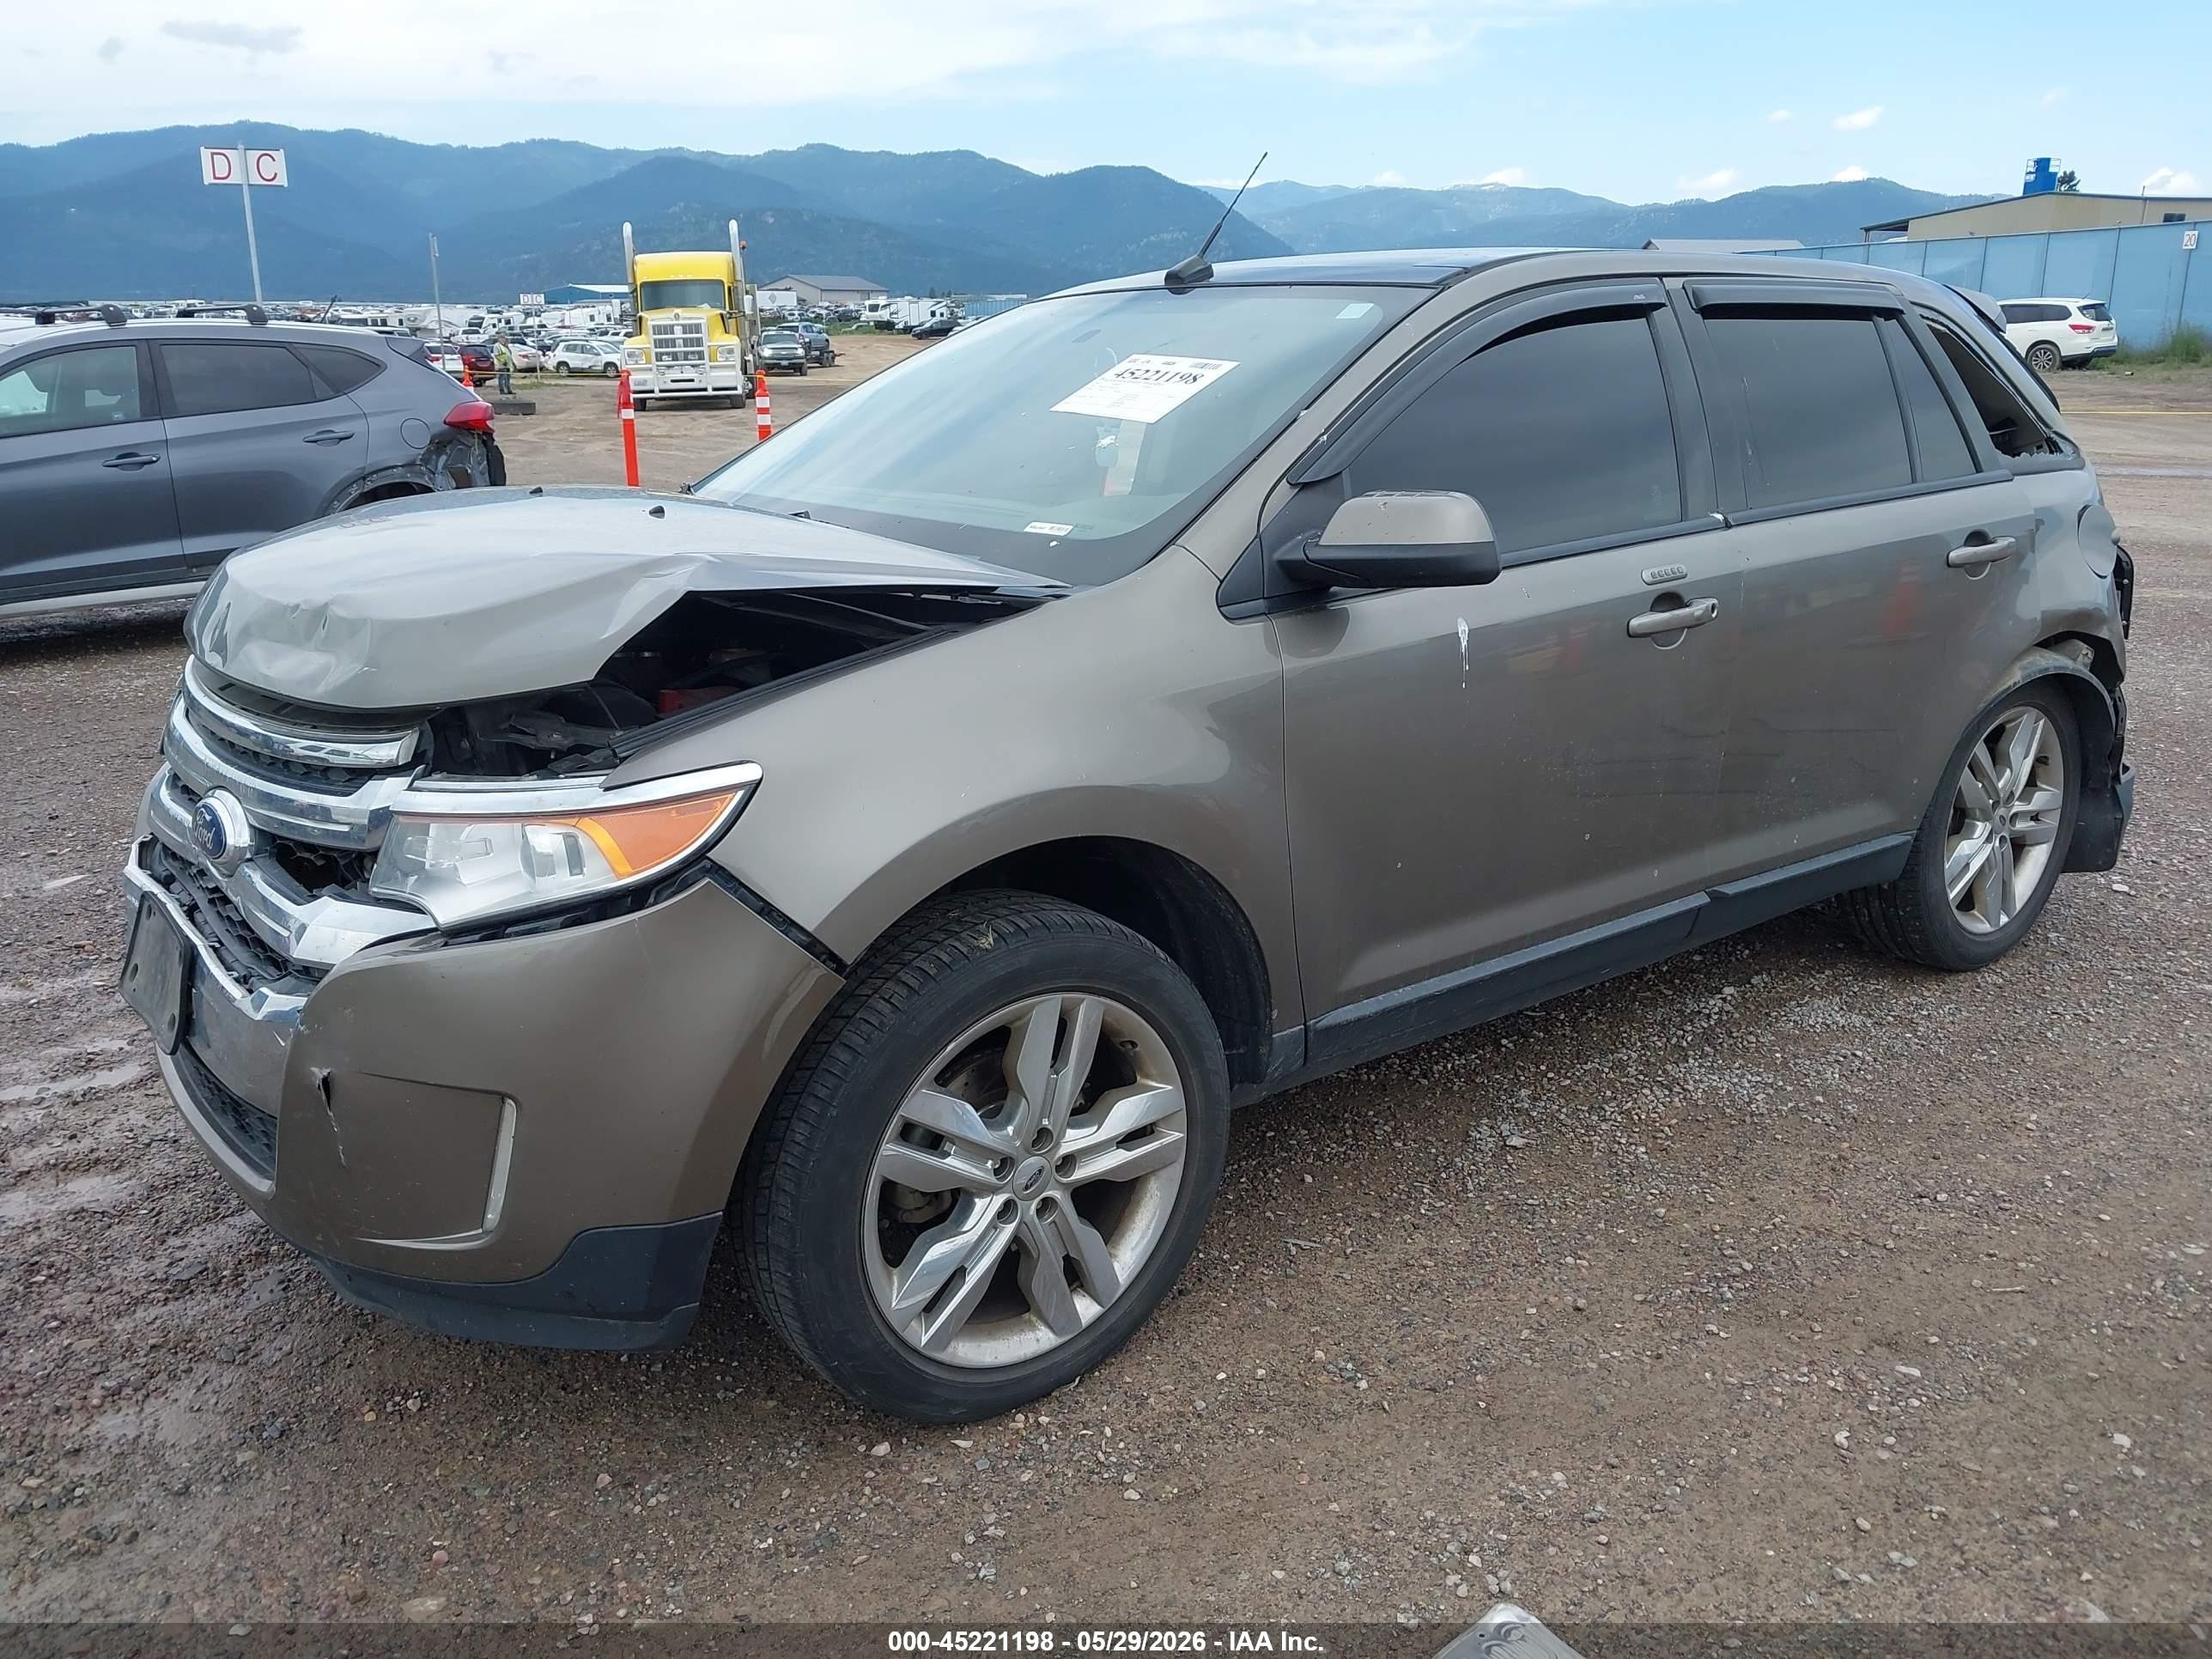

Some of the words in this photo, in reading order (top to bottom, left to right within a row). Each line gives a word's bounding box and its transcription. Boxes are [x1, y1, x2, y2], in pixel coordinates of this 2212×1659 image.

[210, 152, 232, 180] D
[256, 153, 277, 182] C
[2184, 233, 2197, 247] 20
[522, 295, 529, 304] D
[535, 295, 542, 304] C
[1114, 367, 1205, 386] 45221198
[194, 807, 216, 850] Ford
